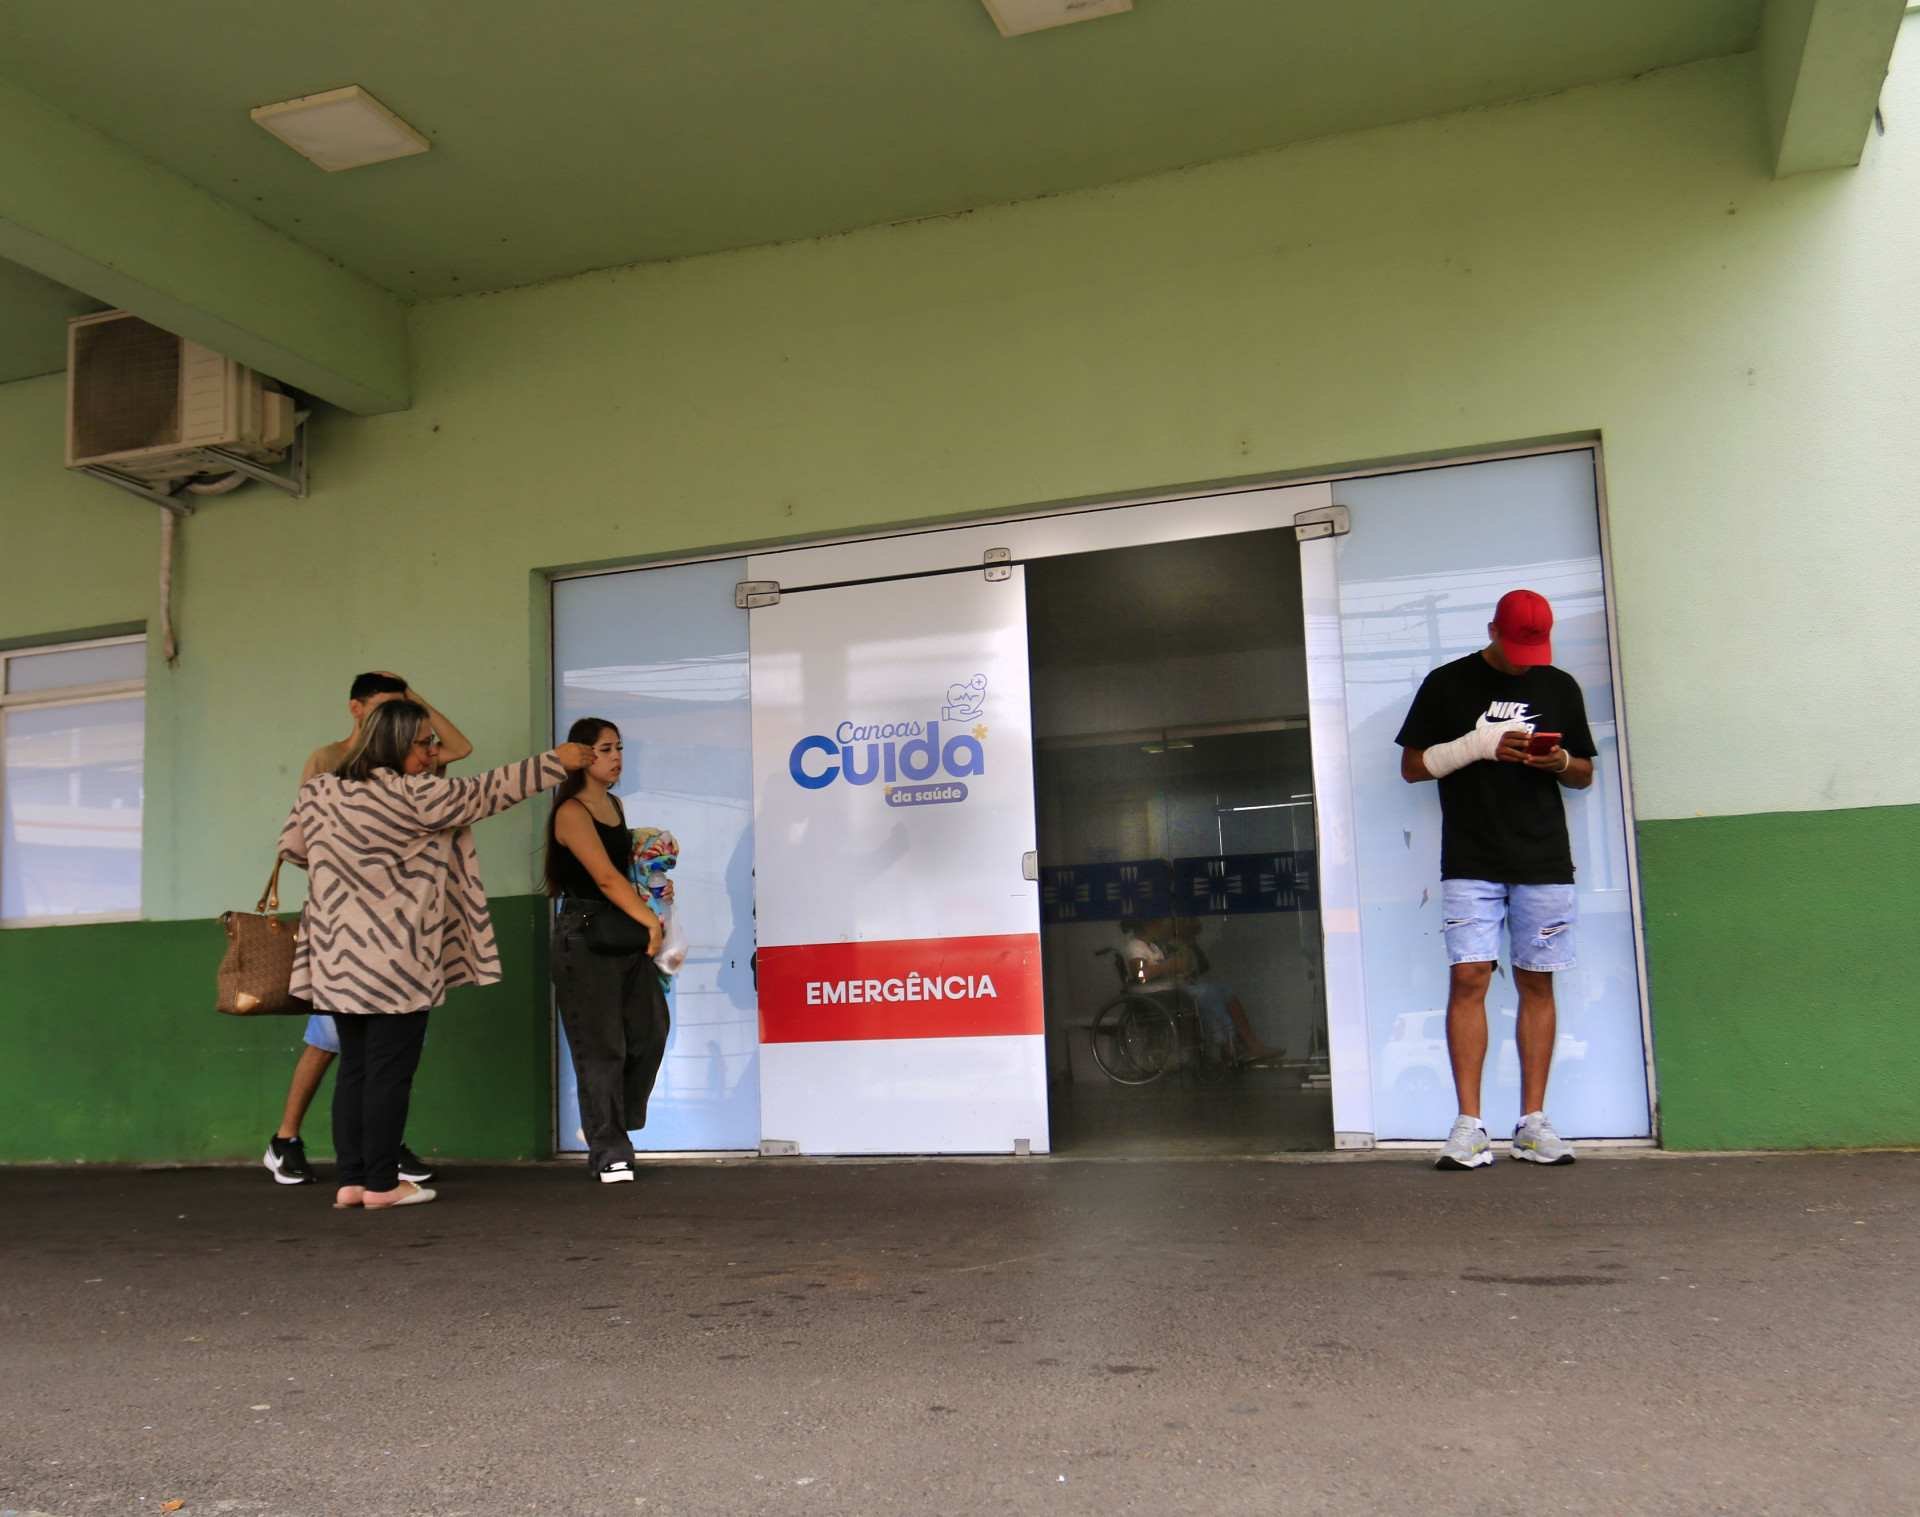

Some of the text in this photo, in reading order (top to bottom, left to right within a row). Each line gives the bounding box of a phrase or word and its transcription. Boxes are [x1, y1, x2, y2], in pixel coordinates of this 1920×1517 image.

[1486, 700, 1530, 719] NIKE
[836, 720, 923, 745] Canoas
[789, 720, 985, 790] Cuida
[892, 786, 961, 804] da saúde
[806, 971, 998, 1005] EMERGÊNCIA
